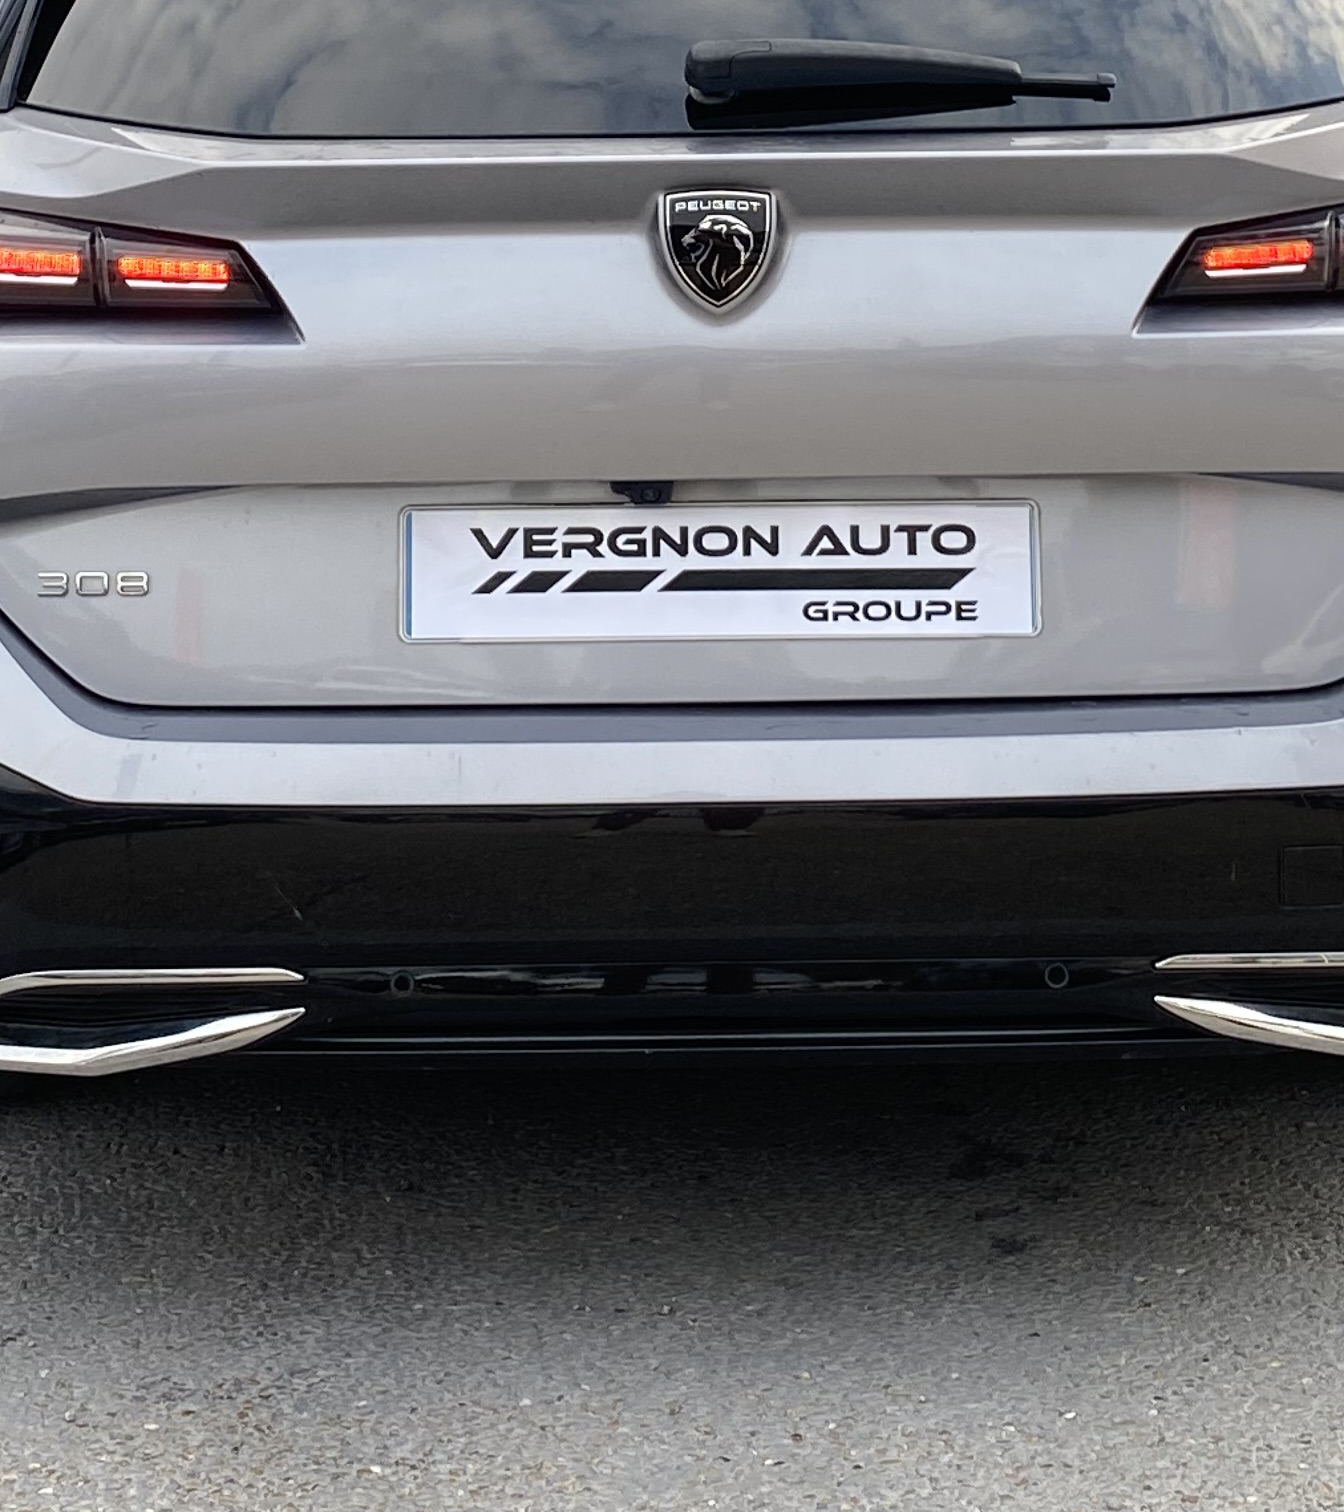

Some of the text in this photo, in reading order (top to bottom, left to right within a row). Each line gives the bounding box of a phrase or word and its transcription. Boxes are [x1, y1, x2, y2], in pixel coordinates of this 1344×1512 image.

[674, 199, 762, 213] PEUGEOT
[469, 523, 977, 560] VERGNON AUTO
[36, 569, 151, 598] 308
[802, 600, 979, 622] GROUPE
